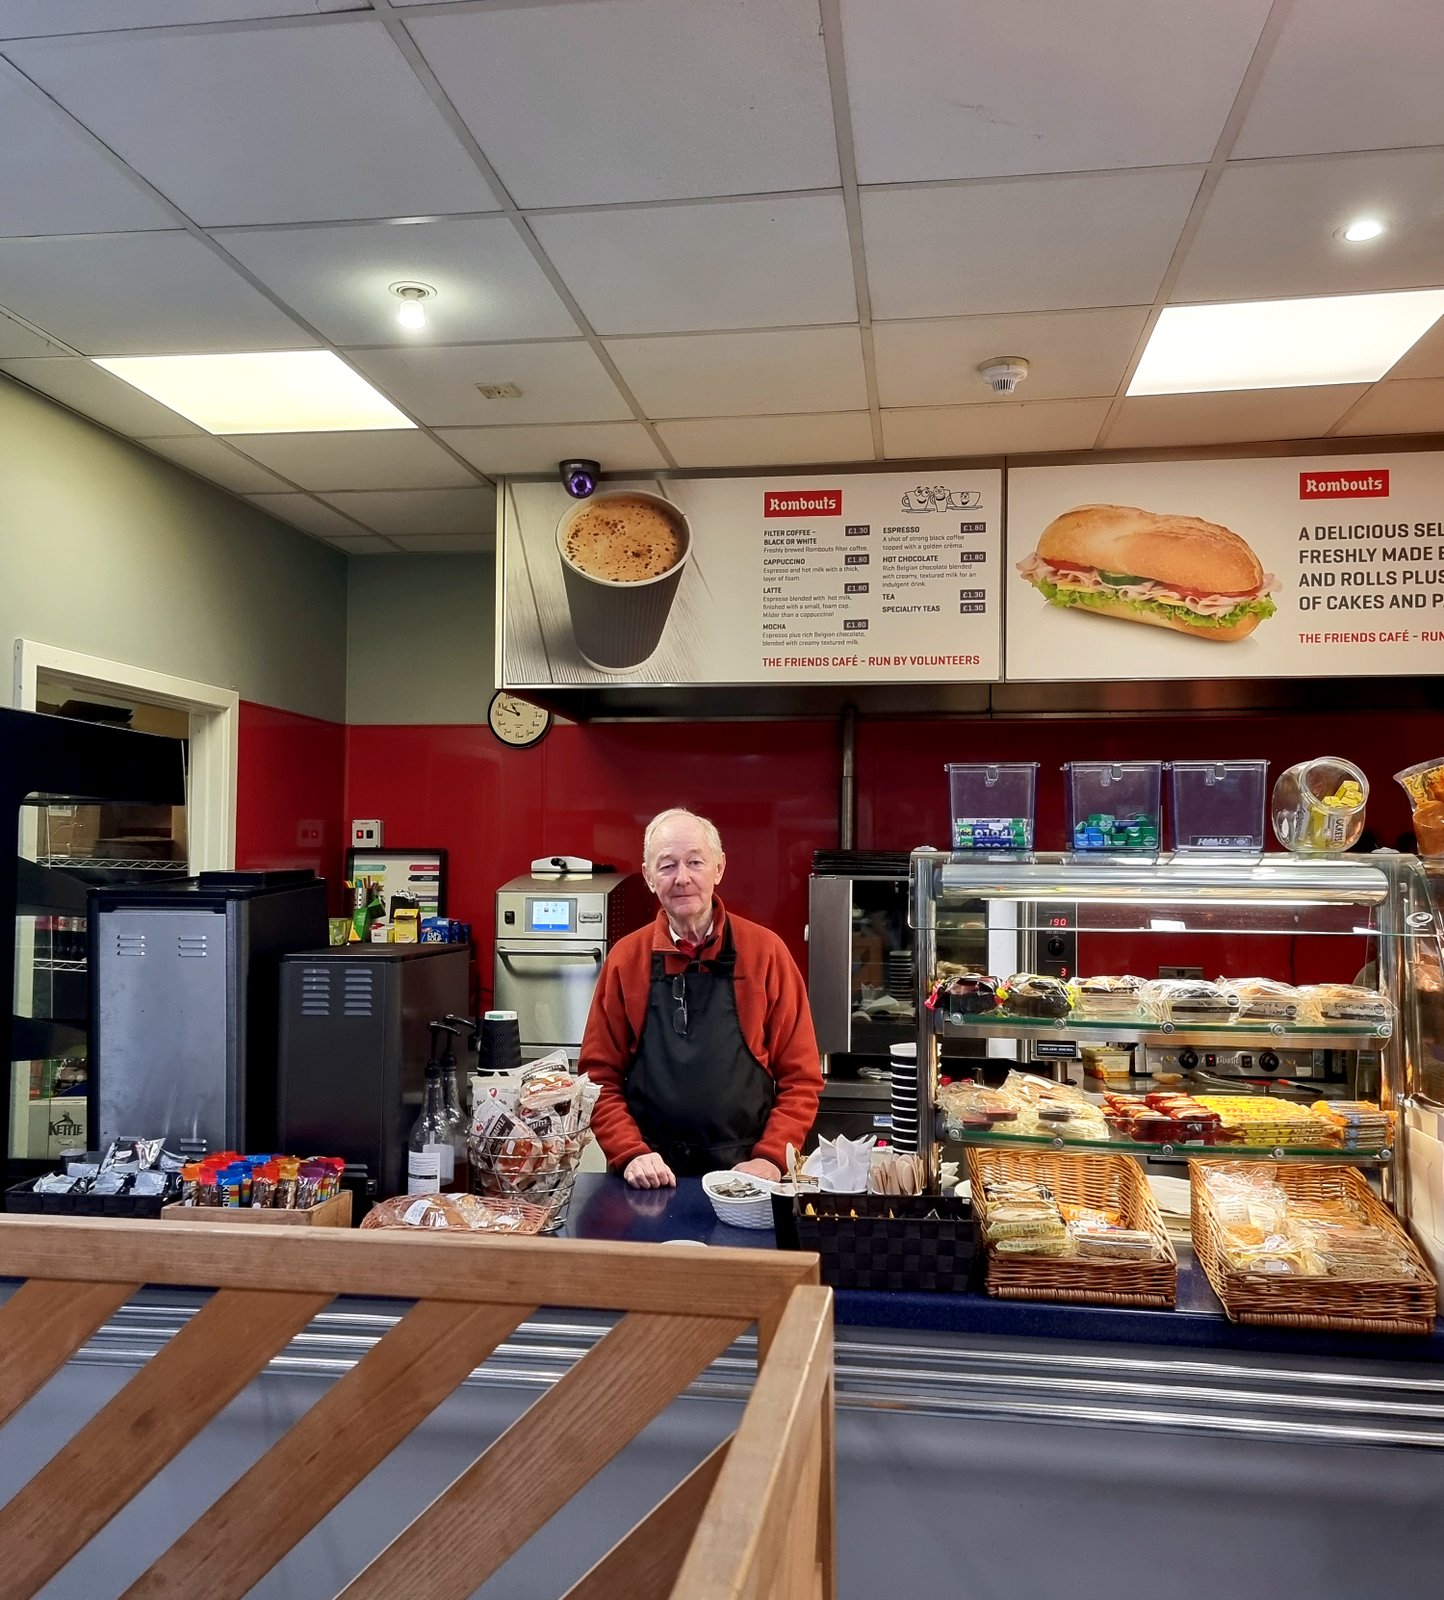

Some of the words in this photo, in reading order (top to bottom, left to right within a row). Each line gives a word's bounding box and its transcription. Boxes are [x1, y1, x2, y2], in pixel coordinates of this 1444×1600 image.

[1306, 476, 1382, 492] Rombouts
[769, 496, 836, 511] Rombouts
[1299, 527, 1310, 541] A
[1315, 524, 1409, 540] DELICIOUS
[1414, 523, 1444, 537] SEL
[1299, 548, 1377, 564] FRESHLY
[1382, 547, 1433, 562] MADE
[1299, 573, 1335, 587] AND
[1341, 571, 1397, 586] ROLLS
[1299, 596, 1322, 610] OF
[1327, 595, 1384, 610] CAKES
[1389, 594, 1426, 608] AND
[1432, 594, 1444, 608] P
[1299, 634, 1321, 643] THE
[1324, 633, 1376, 643] FRIENDS
[1379, 630, 1409, 642] CAFÉ
[762, 657, 782, 667] THE
[785, 657, 829, 666] FRIENDS
[832, 655, 857, 666] CAFÉ
[868, 657, 890, 666] RUN
[894, 657, 907, 665] BY
[910, 655, 979, 665] VOLUNTEERS
[1197, 838, 1230, 846] HLS
[1049, 918, 1067, 926] 190
[1060, 967, 1067, 977] 3
[49, 1121, 83, 1136] KETTLE
[222, 1185, 230, 1207] KIND
